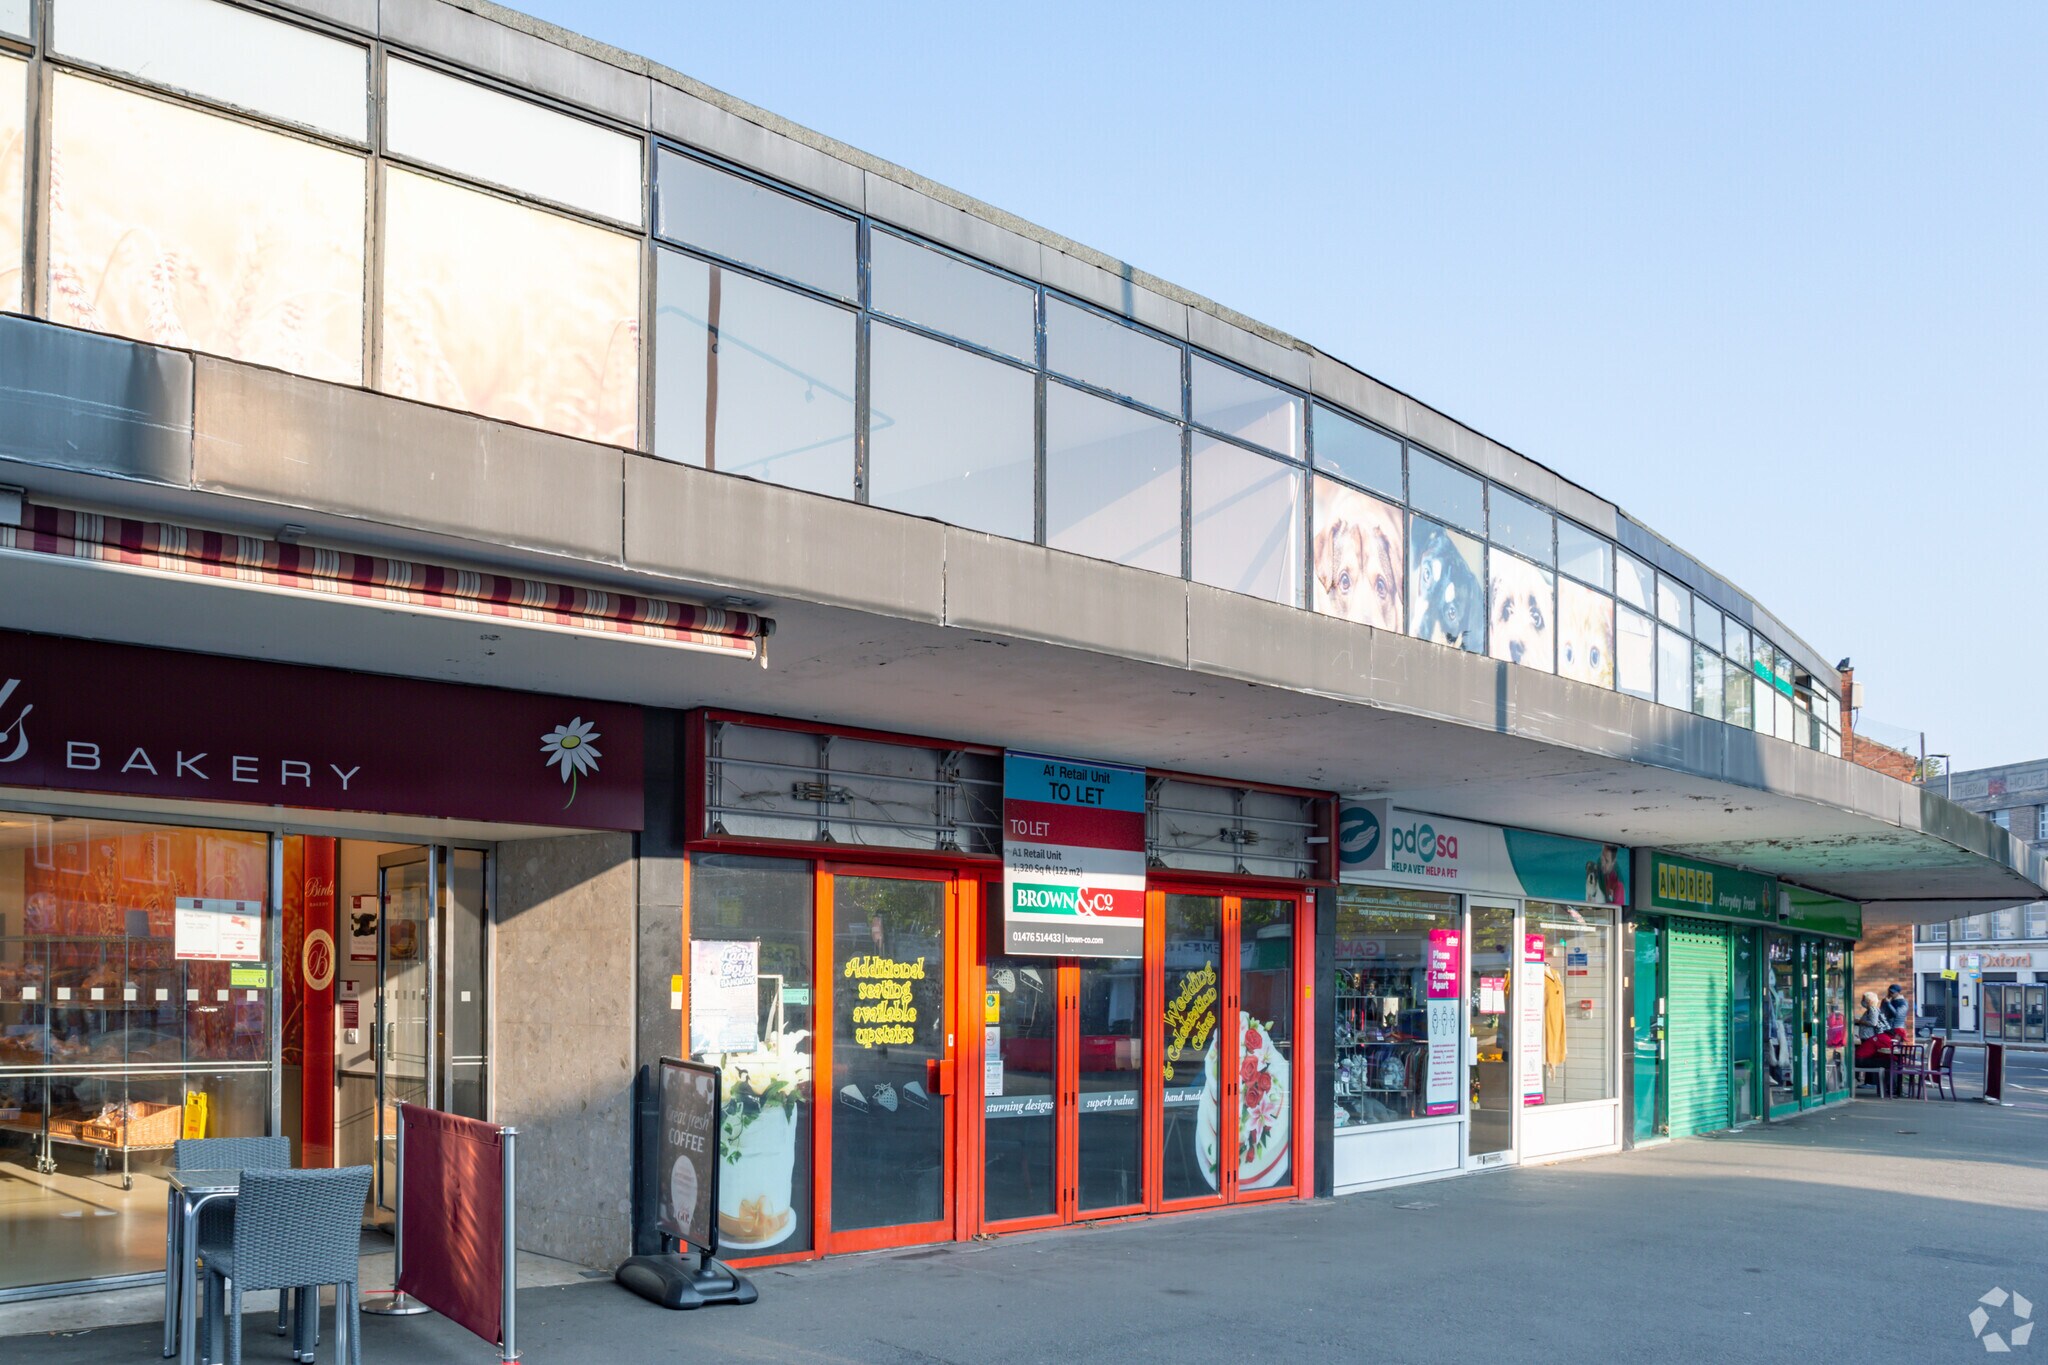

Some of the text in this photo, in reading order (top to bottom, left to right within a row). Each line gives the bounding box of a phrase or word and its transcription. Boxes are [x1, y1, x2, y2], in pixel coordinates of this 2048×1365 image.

[66, 741, 361, 790] BAKERY
[1043, 764, 1111, 784] A1 Retail Unit
[1049, 782, 1105, 805] TO LET
[1010, 819, 1050, 836] TO LET
[1012, 848, 1062, 861] A1 Retail Unit
[1013, 863, 1034, 874] 1,320
[1034, 865, 1044, 876] Sq
[1045, 864, 1052, 875] ft
[1052, 866, 1068, 877] (122
[1391, 861, 1408, 873] HELP
[1412, 864, 1425, 875] VET
[1425, 865, 1441, 877] HELP
[1447, 868, 1458, 878] PET
[305, 877, 334, 897] Birds
[1719, 892, 1756, 912] Everyday Fresh
[1012, 931, 1104, 944] 01476 514433 brown-co.com
[721, 949, 754, 966] Lady
[1433, 949, 1450, 960] Please
[844, 956, 925, 979] Additional
[1433, 959, 1447, 972] Keep
[1432, 970, 1456, 980] 2 metres
[858, 980, 913, 1003] seating
[1163, 960, 1216, 1028] Wedding
[1432, 980, 1449, 992] Apart
[853, 1000, 917, 1024] available
[1167, 987, 1217, 1062] Celebration
[1192, 1011, 1216, 1051] Cakes
[855, 1024, 914, 1048] upstairs
[1086, 1094, 1135, 1111] superb value
[1164, 1091, 1183, 1102] hand
[1024, 1098, 1054, 1114] designs
[668, 1127, 705, 1153] COFFEE
